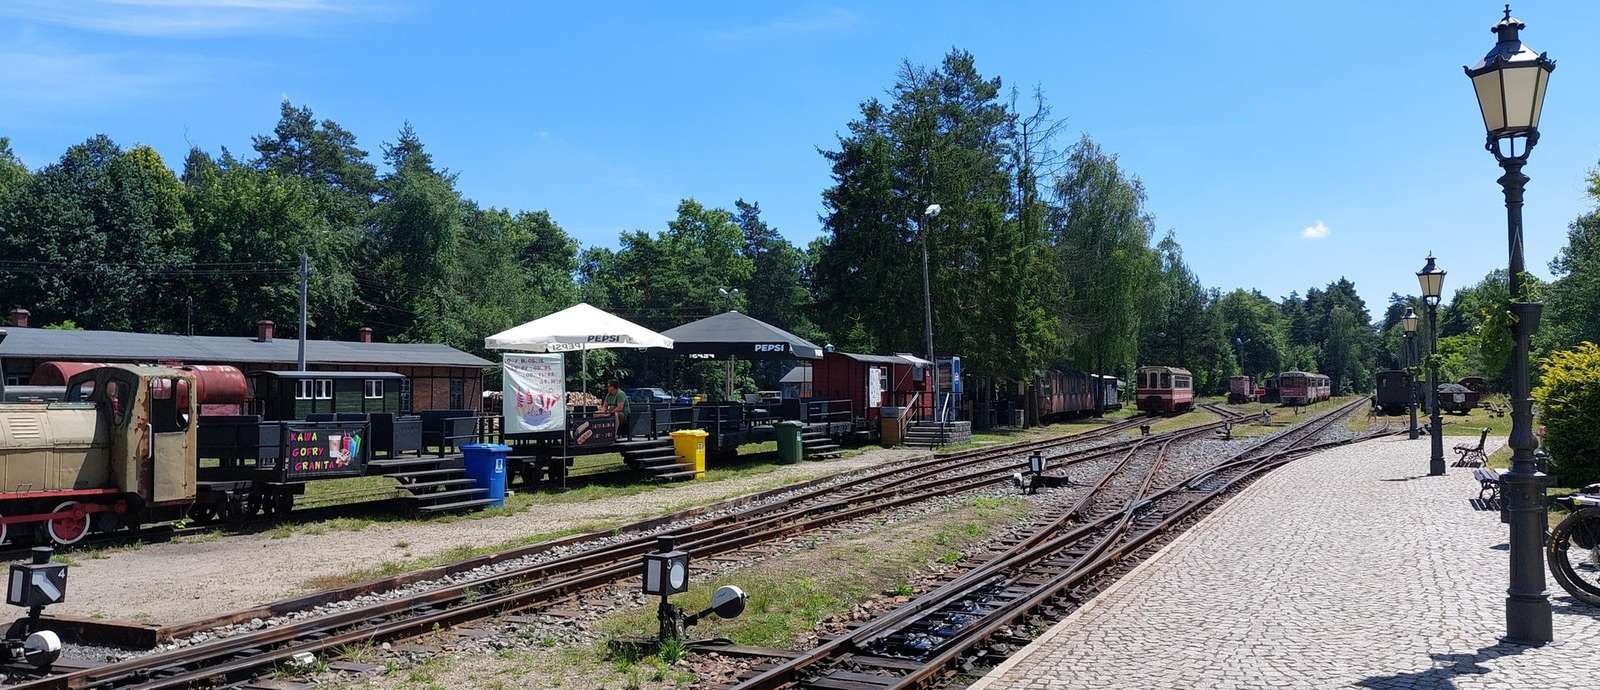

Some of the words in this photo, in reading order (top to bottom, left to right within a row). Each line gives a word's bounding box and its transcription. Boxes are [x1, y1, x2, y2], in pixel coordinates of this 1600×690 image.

[754, 344, 785, 352] PEPSI
[290, 432, 318, 442] KAWA
[292, 447, 324, 457] GOFRY
[294, 461, 334, 471] GRANITA
[667, 559, 672, 569] 3
[58, 568, 65, 578] 4
